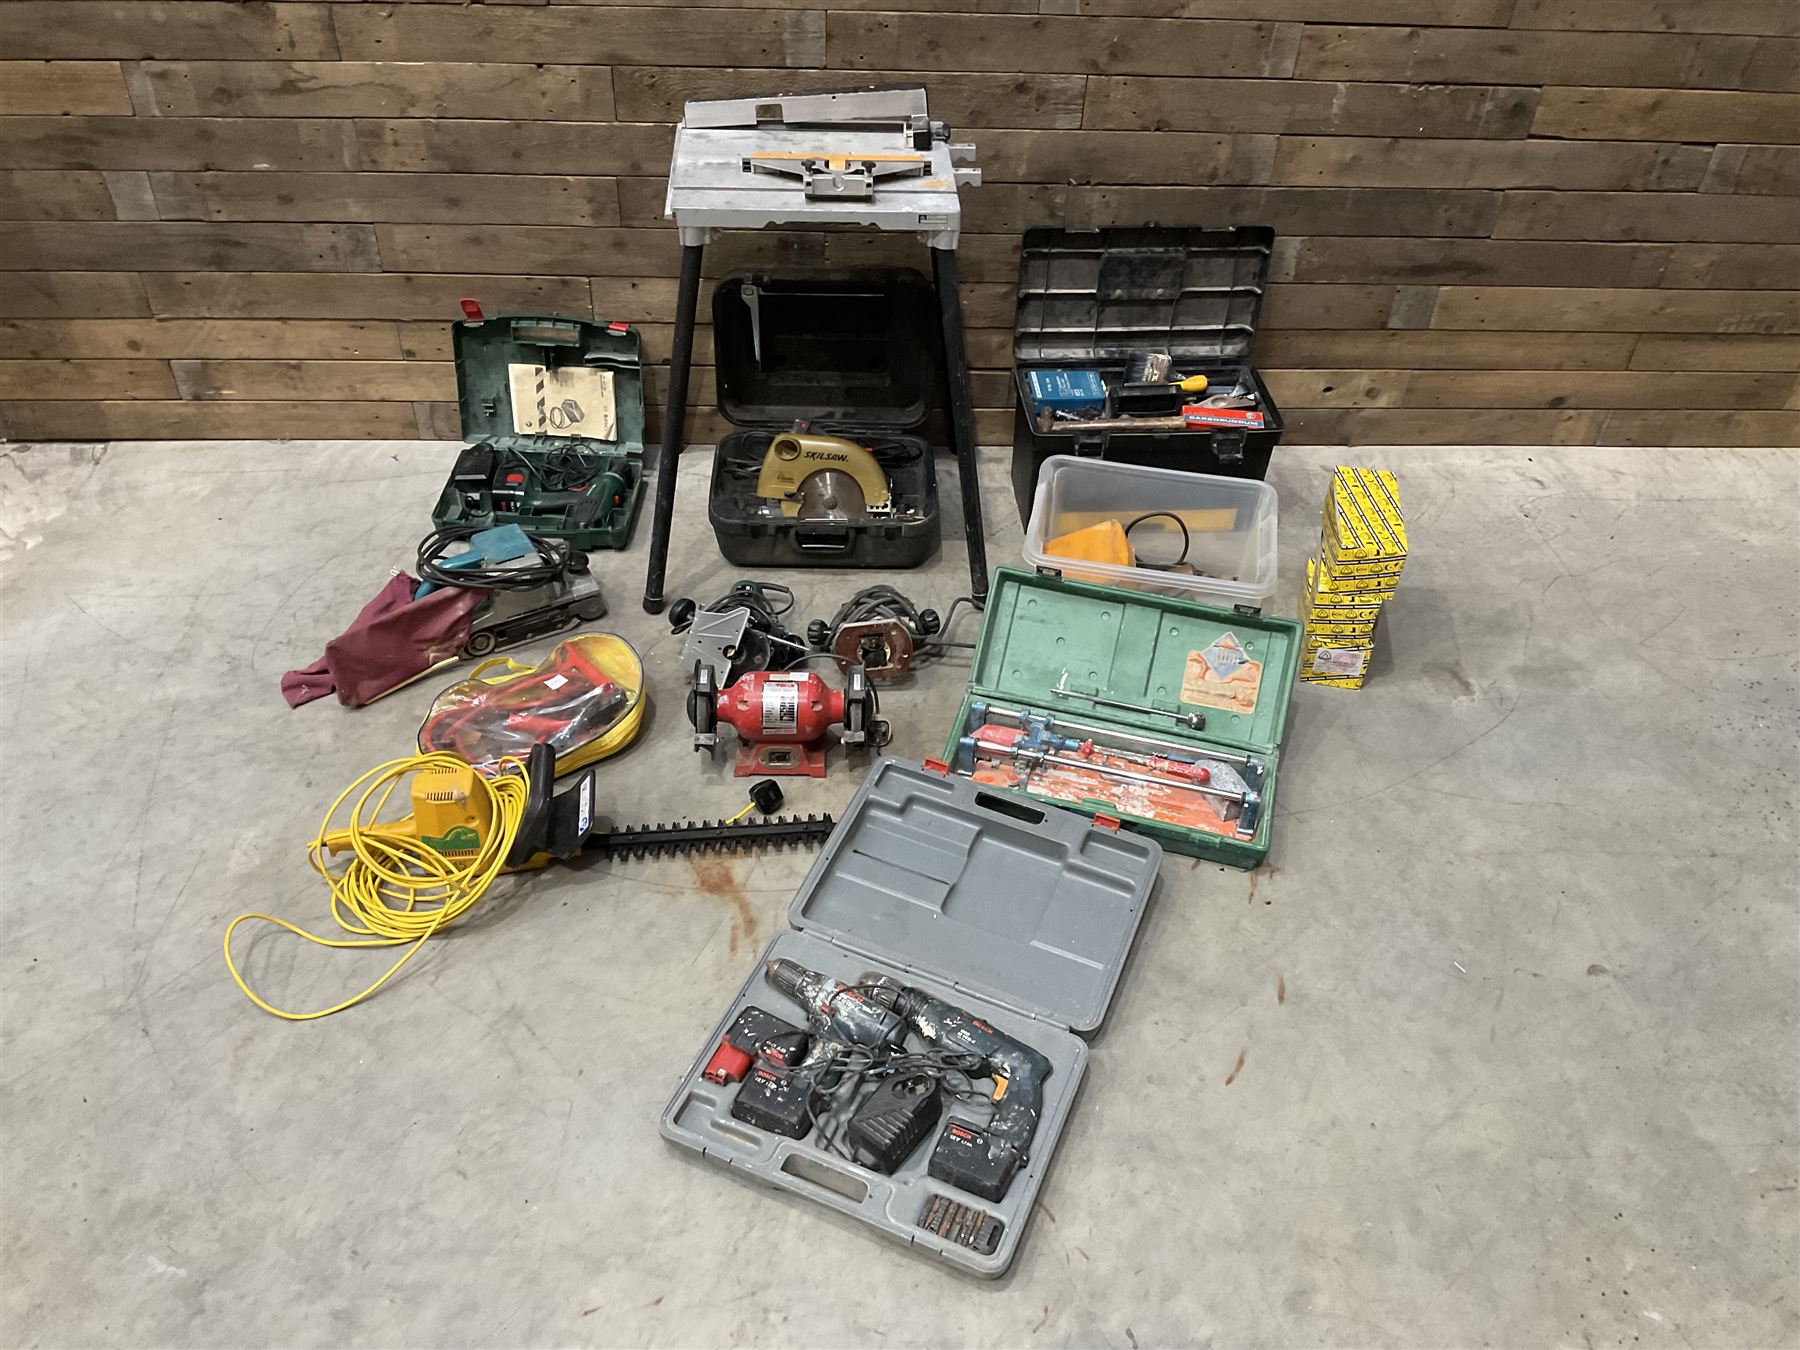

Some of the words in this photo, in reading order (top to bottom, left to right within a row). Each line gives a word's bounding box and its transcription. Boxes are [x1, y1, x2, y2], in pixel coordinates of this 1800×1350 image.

[1188, 415, 1259, 427] CARBORUNDUM
[757, 1070, 777, 1081] BOSCH
[951, 1128, 972, 1140] BOSCH
